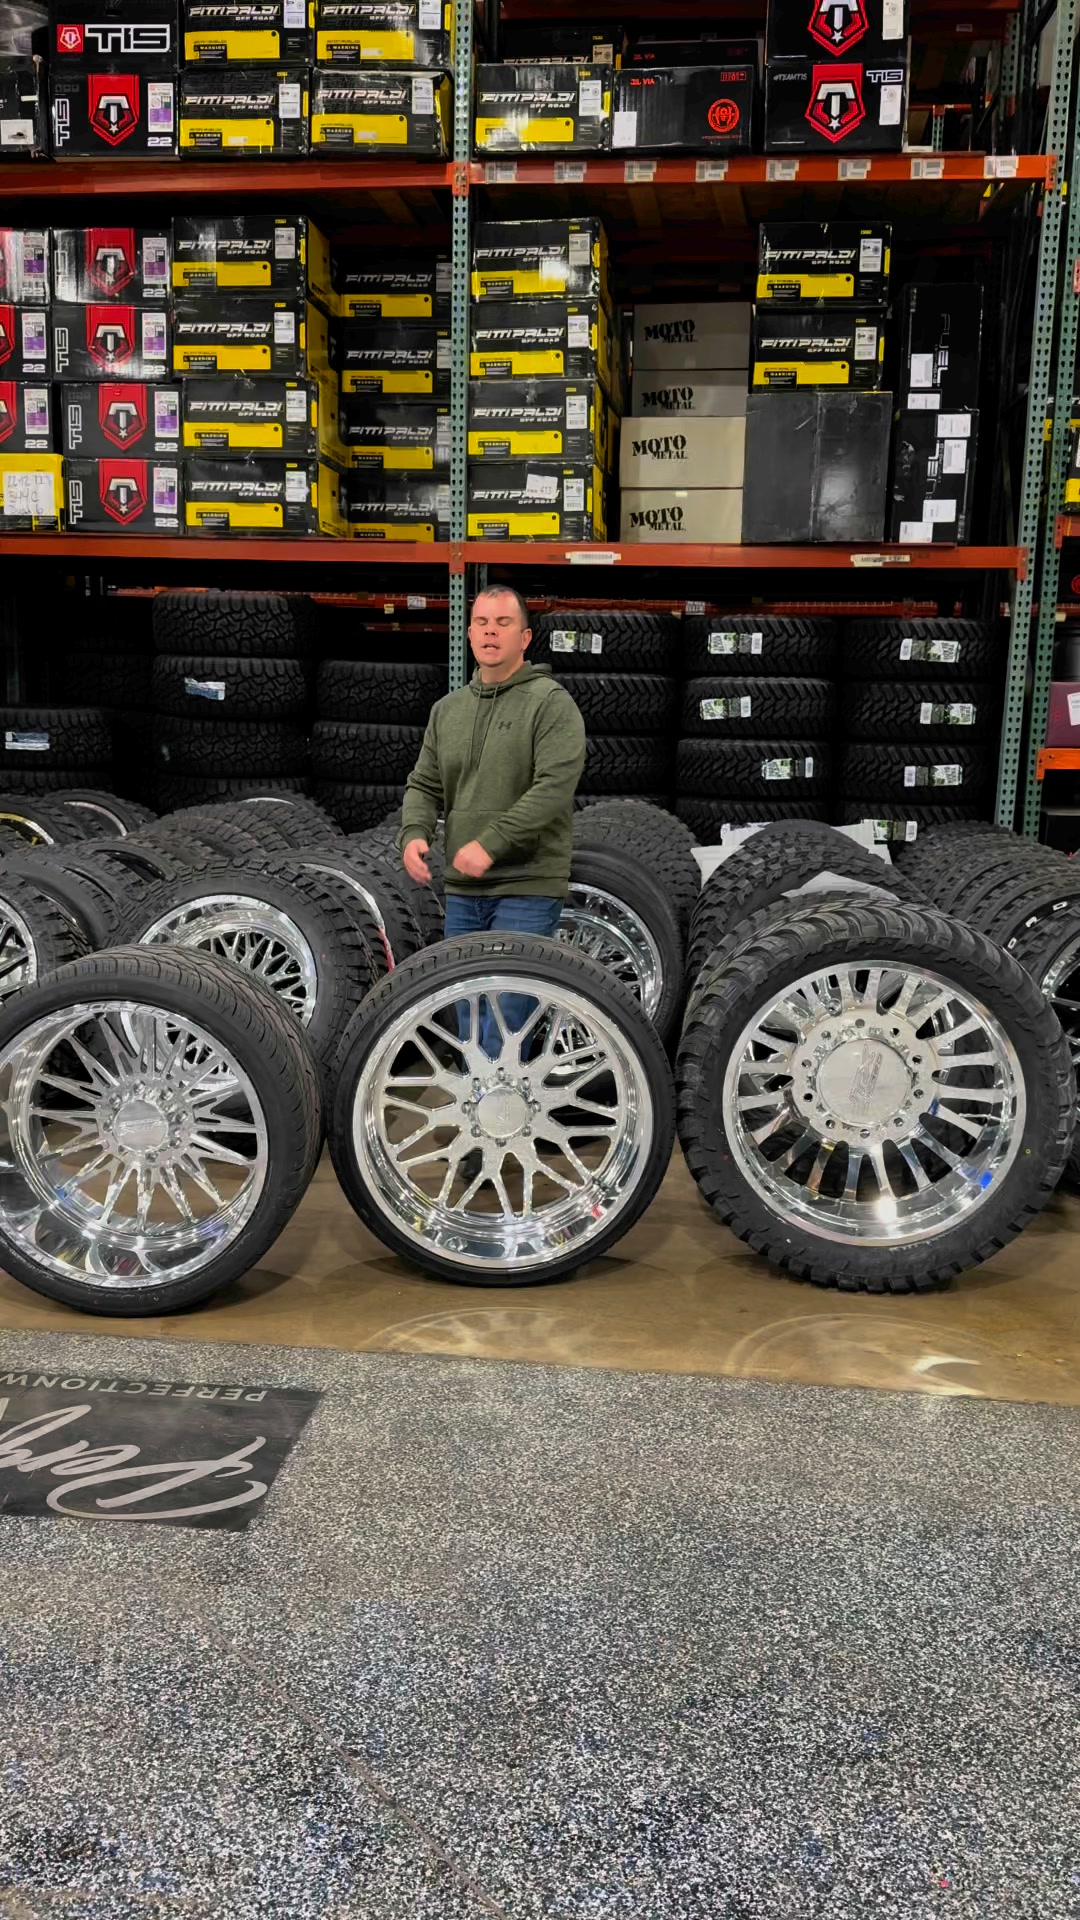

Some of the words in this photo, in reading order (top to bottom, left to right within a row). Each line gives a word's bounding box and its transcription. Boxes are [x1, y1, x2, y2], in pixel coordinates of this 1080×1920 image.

[190, 6, 278, 17] FITTIPALDI
[323, 5, 414, 15] FITTIPALDI
[85, 24, 170, 52] TIS
[866, 69, 903, 83] TIS
[318, 90, 406, 99] FITTIPALDI
[482, 93, 575, 102] FITTIPALDI
[185, 96, 274, 104] FITTIPALDI
[55, 99, 70, 146] TIS
[148, 137, 172, 146] 22
[179, 240, 271, 250] FITTIPALDI
[476, 246, 566, 258] FITTIPALDI
[764, 251, 856, 260] FITTIPALDI
[346, 274, 432, 282] FITTIPALDI
[142, 289, 166, 297] 22
[178, 324, 271, 332] FITTIPALDI
[644, 319, 695, 341] MOTO
[476, 328, 564, 339] FITTIPALDI
[663, 334, 694, 343] METAL
[761, 338, 851, 348] FITTIPALDI
[55, 327, 69, 373] TIS
[347, 351, 433, 359] FITTIPALDI
[22, 364, 46, 373] 22
[142, 365, 165, 374] 22
[641, 386, 693, 407] MOTO
[190, 402, 282, 411] FITTIPALDI
[661, 401, 693, 410] METAL
[473, 407, 563, 417] FITTIPALDI
[68, 405, 82, 449] TIS
[349, 427, 433, 435] FITTIPALDI
[25, 440, 48, 449] 22
[155, 442, 178, 452] 22
[632, 435, 686, 456] MOTO
[652, 451, 686, 459] METAL
[926, 443, 939, 498] UEL
[191, 482, 282, 491] FITTIPALDI
[472, 490, 560, 499] FITTIPI
[69, 480, 83, 524] TIS
[350, 503, 434, 512] FITTIPALDI
[629, 506, 683, 528] MOTO
[155, 518, 178, 527] 22
[649, 522, 684, 531] METAL
[0, 1372, 268, 1402] PERFECTIONW
